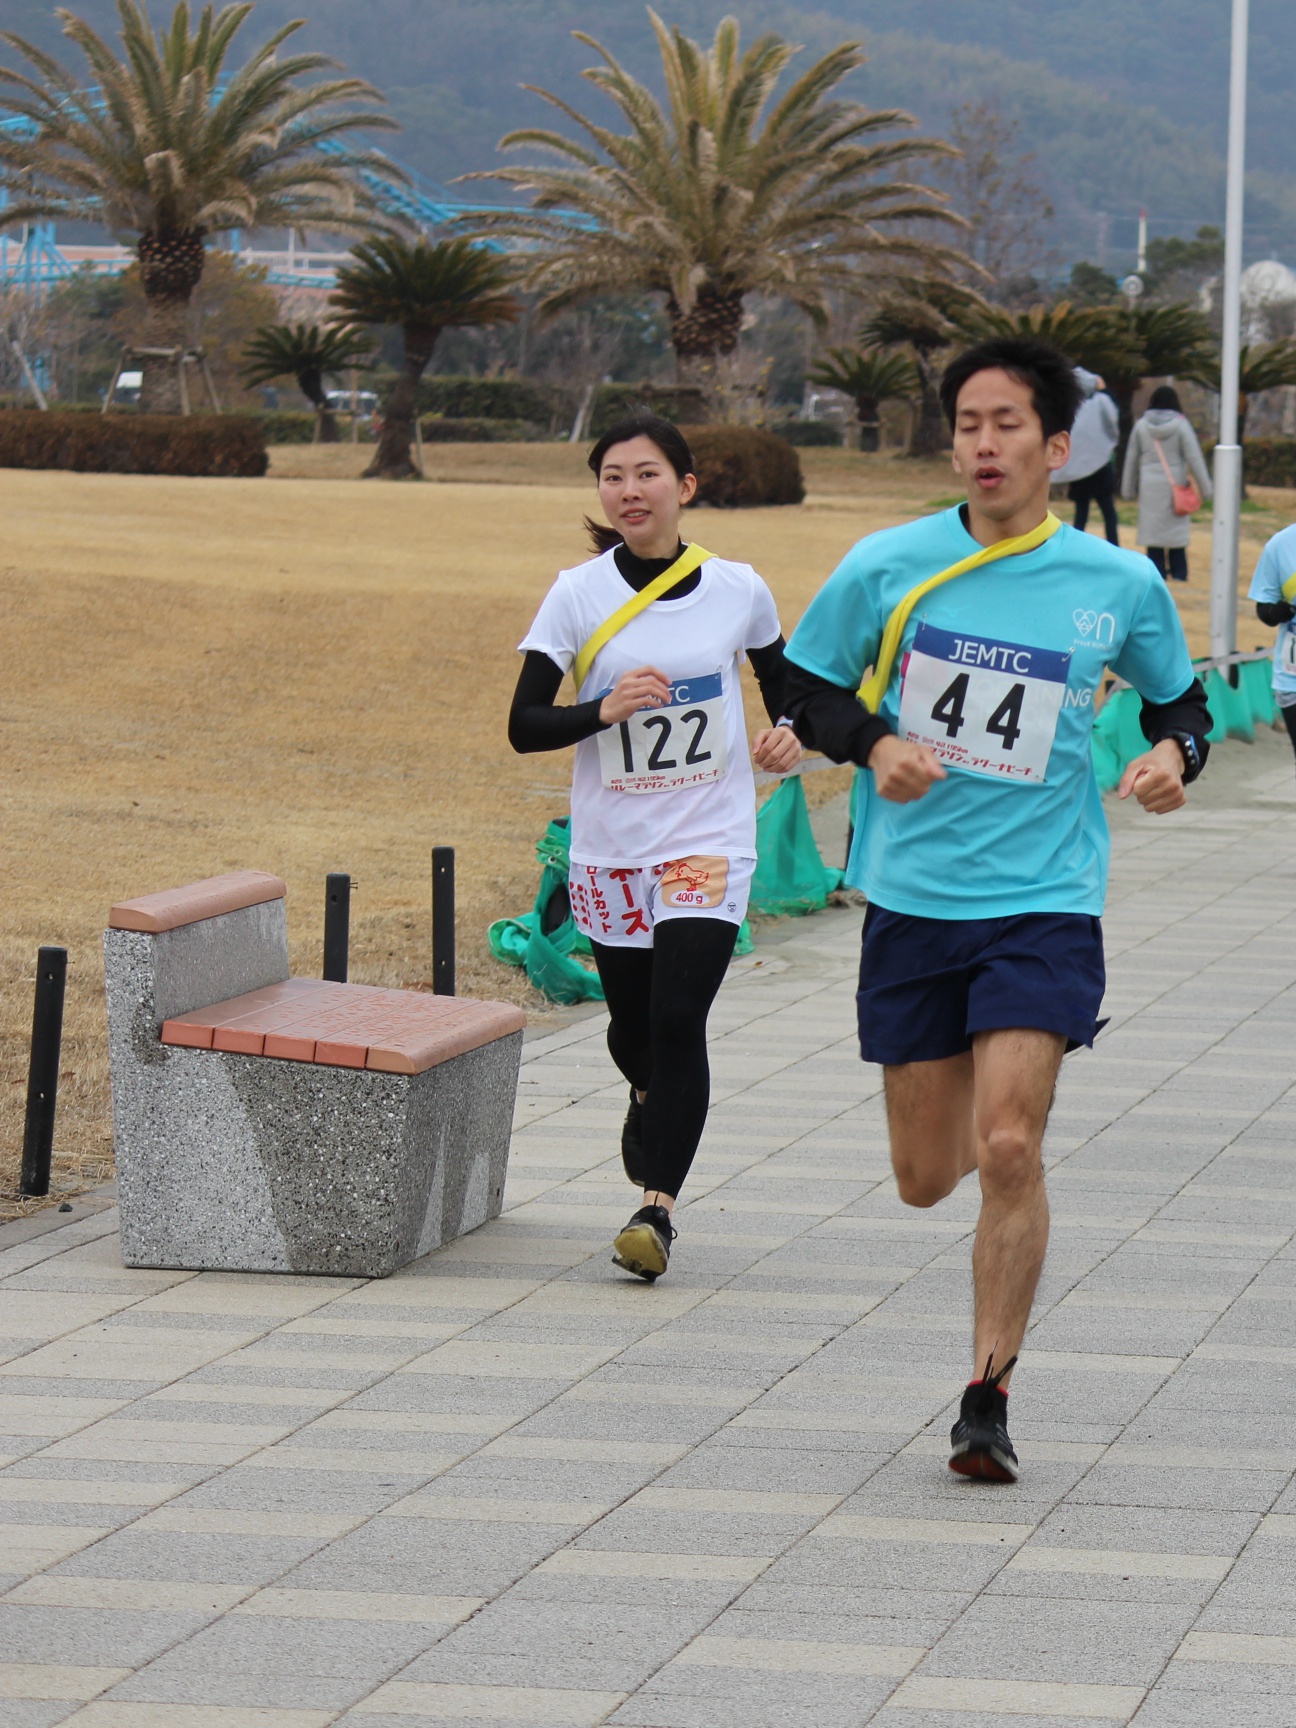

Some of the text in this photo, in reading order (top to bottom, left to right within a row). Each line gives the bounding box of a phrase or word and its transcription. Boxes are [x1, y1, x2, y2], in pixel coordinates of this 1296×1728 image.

[949, 639, 1031, 673] JEMTC
[619, 709, 712, 773] 122
[930, 672, 1026, 751] 44
[587, 866, 612, 933] ロールカット
[675, 892, 703, 905] 400 g
